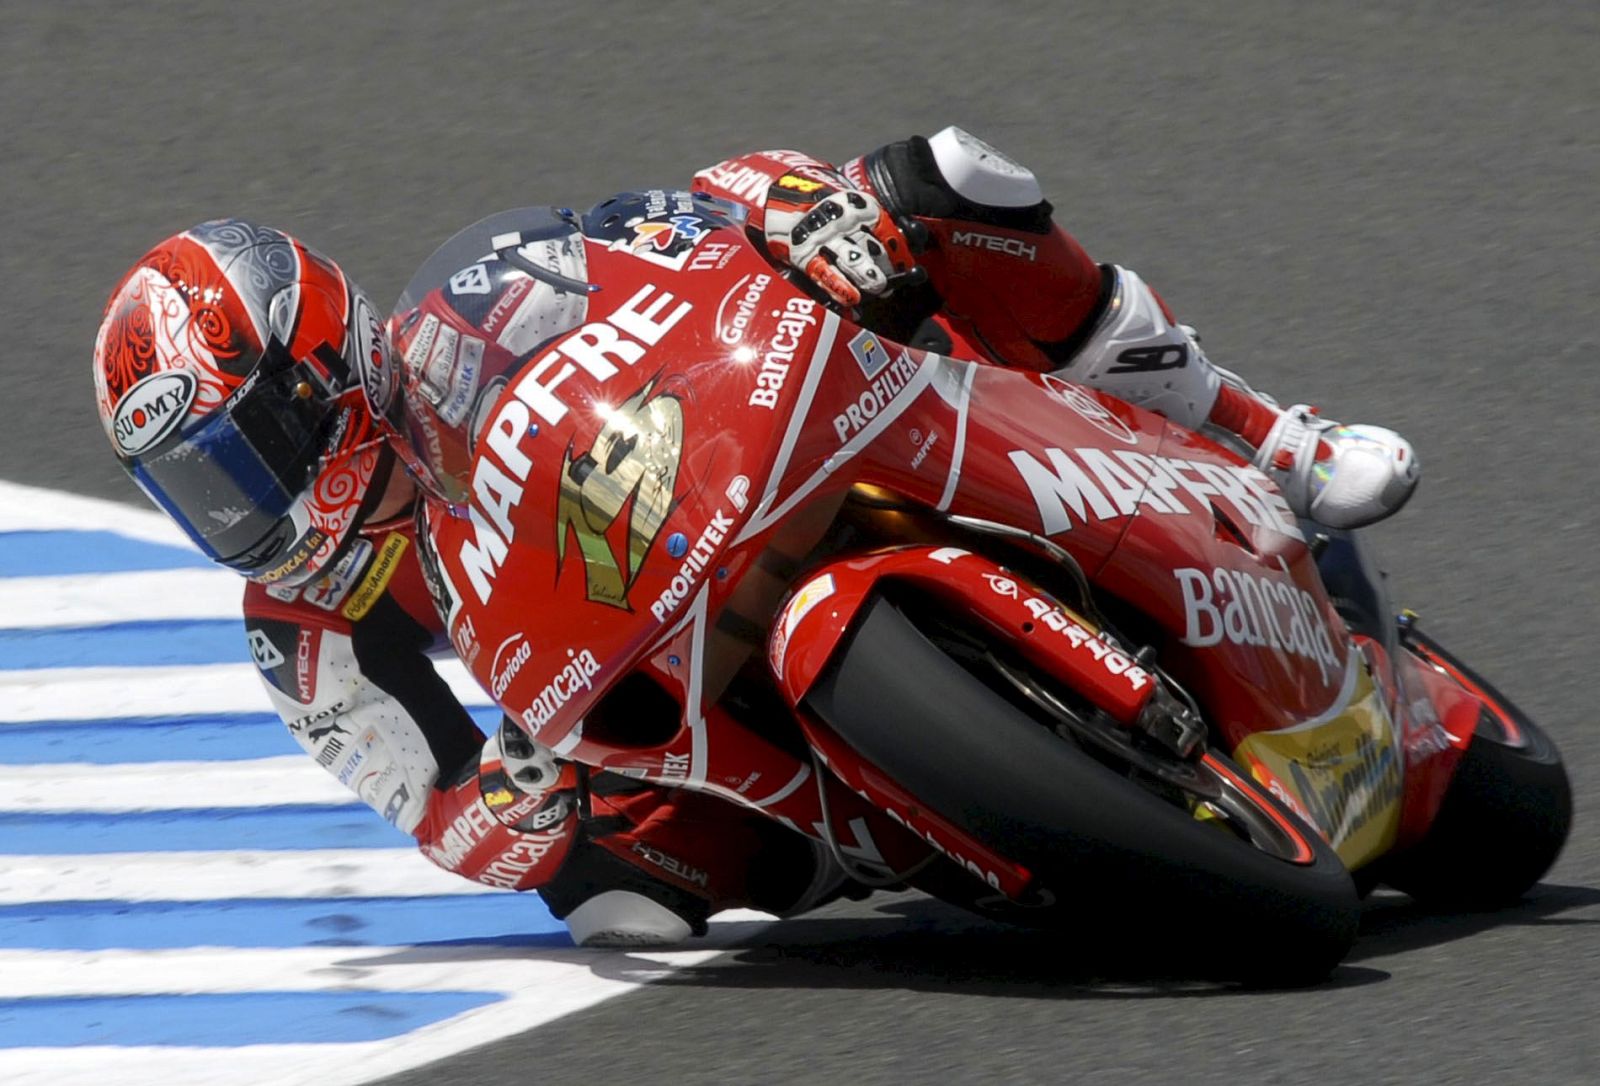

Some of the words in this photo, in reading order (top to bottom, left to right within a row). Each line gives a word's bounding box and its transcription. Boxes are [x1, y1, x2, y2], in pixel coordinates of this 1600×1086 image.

[952, 230, 1036, 262] MTECH
[483, 276, 533, 331] MTECH
[722, 273, 771, 345] Gaviota
[367, 317, 388, 403] SUOMY
[749, 297, 816, 410] Bancaja
[832, 348, 919, 444] PROFILTEK
[116, 386, 183, 440] SUOMY
[459, 284, 693, 605] MAPFRE
[910, 430, 938, 470] MAPFRE
[1007, 447, 1307, 537] MAPFRE
[650, 509, 735, 624] PROFILTEK
[1173, 554, 1342, 688] Bancaja
[297, 630, 312, 700] MTECH
[491, 640, 532, 700] Gaviota
[522, 648, 602, 737] Bancaja
